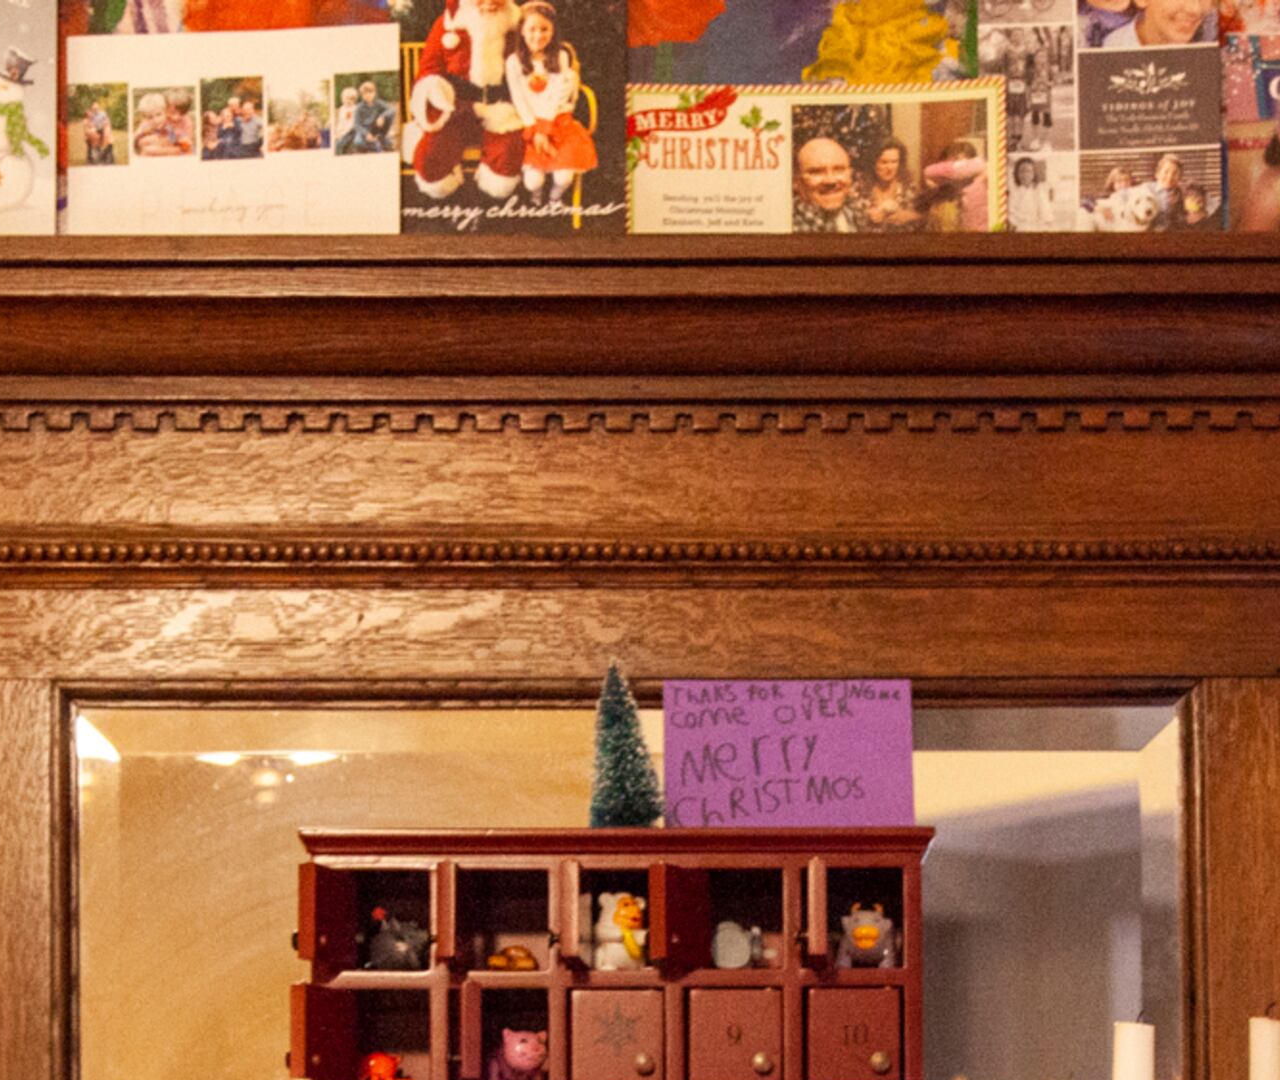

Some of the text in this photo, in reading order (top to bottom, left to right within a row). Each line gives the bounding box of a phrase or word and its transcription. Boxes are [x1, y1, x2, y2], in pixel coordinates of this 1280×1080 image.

[635, 109, 717, 131] MERRY
[639, 130, 785, 170] CHRISTMAS
[403, 195, 625, 231] merry christmas
[681, 735, 819, 787] Merry
[726, 1025, 742, 1046] 9
[843, 1024, 869, 1046] 10
